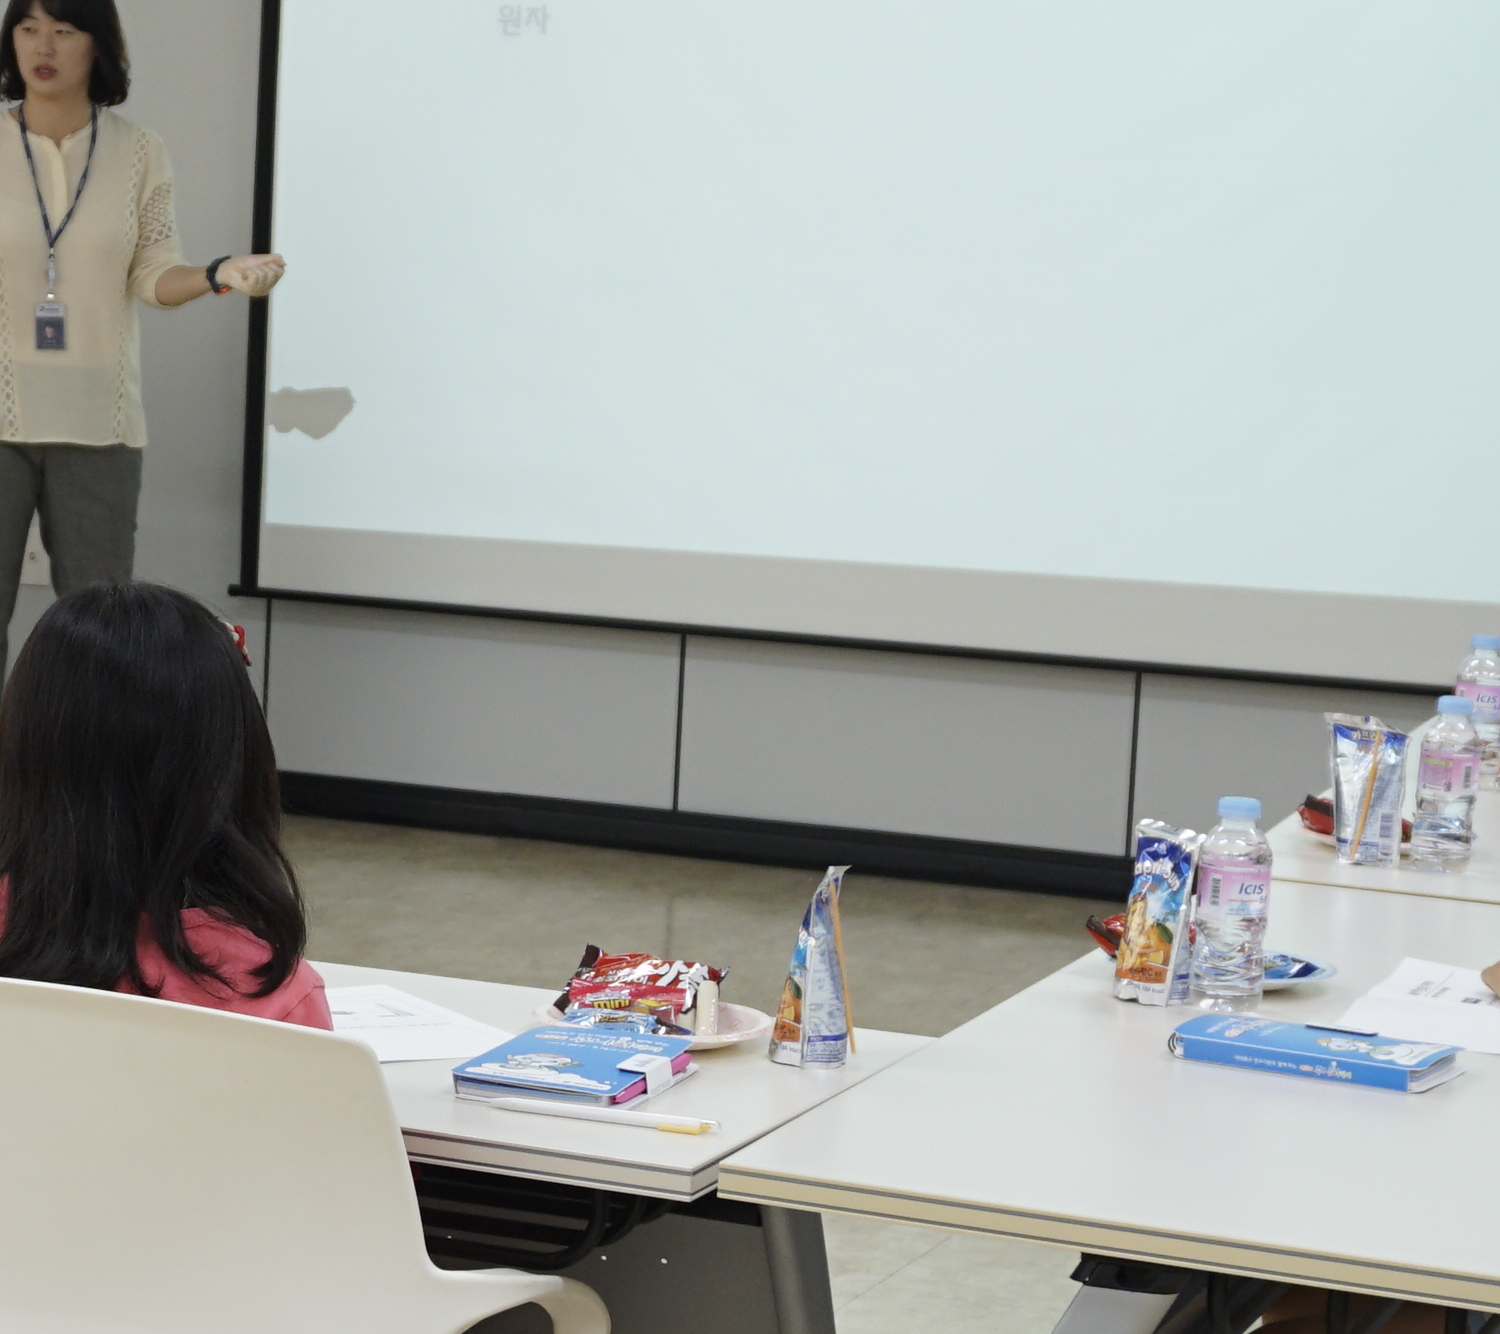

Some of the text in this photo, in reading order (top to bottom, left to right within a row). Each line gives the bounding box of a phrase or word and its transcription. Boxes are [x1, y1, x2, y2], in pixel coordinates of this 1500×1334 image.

[498, 4, 551, 37] 원자
[1134, 857, 1181, 892] apri-Sun
[1238, 881, 1265, 896] ICIS
